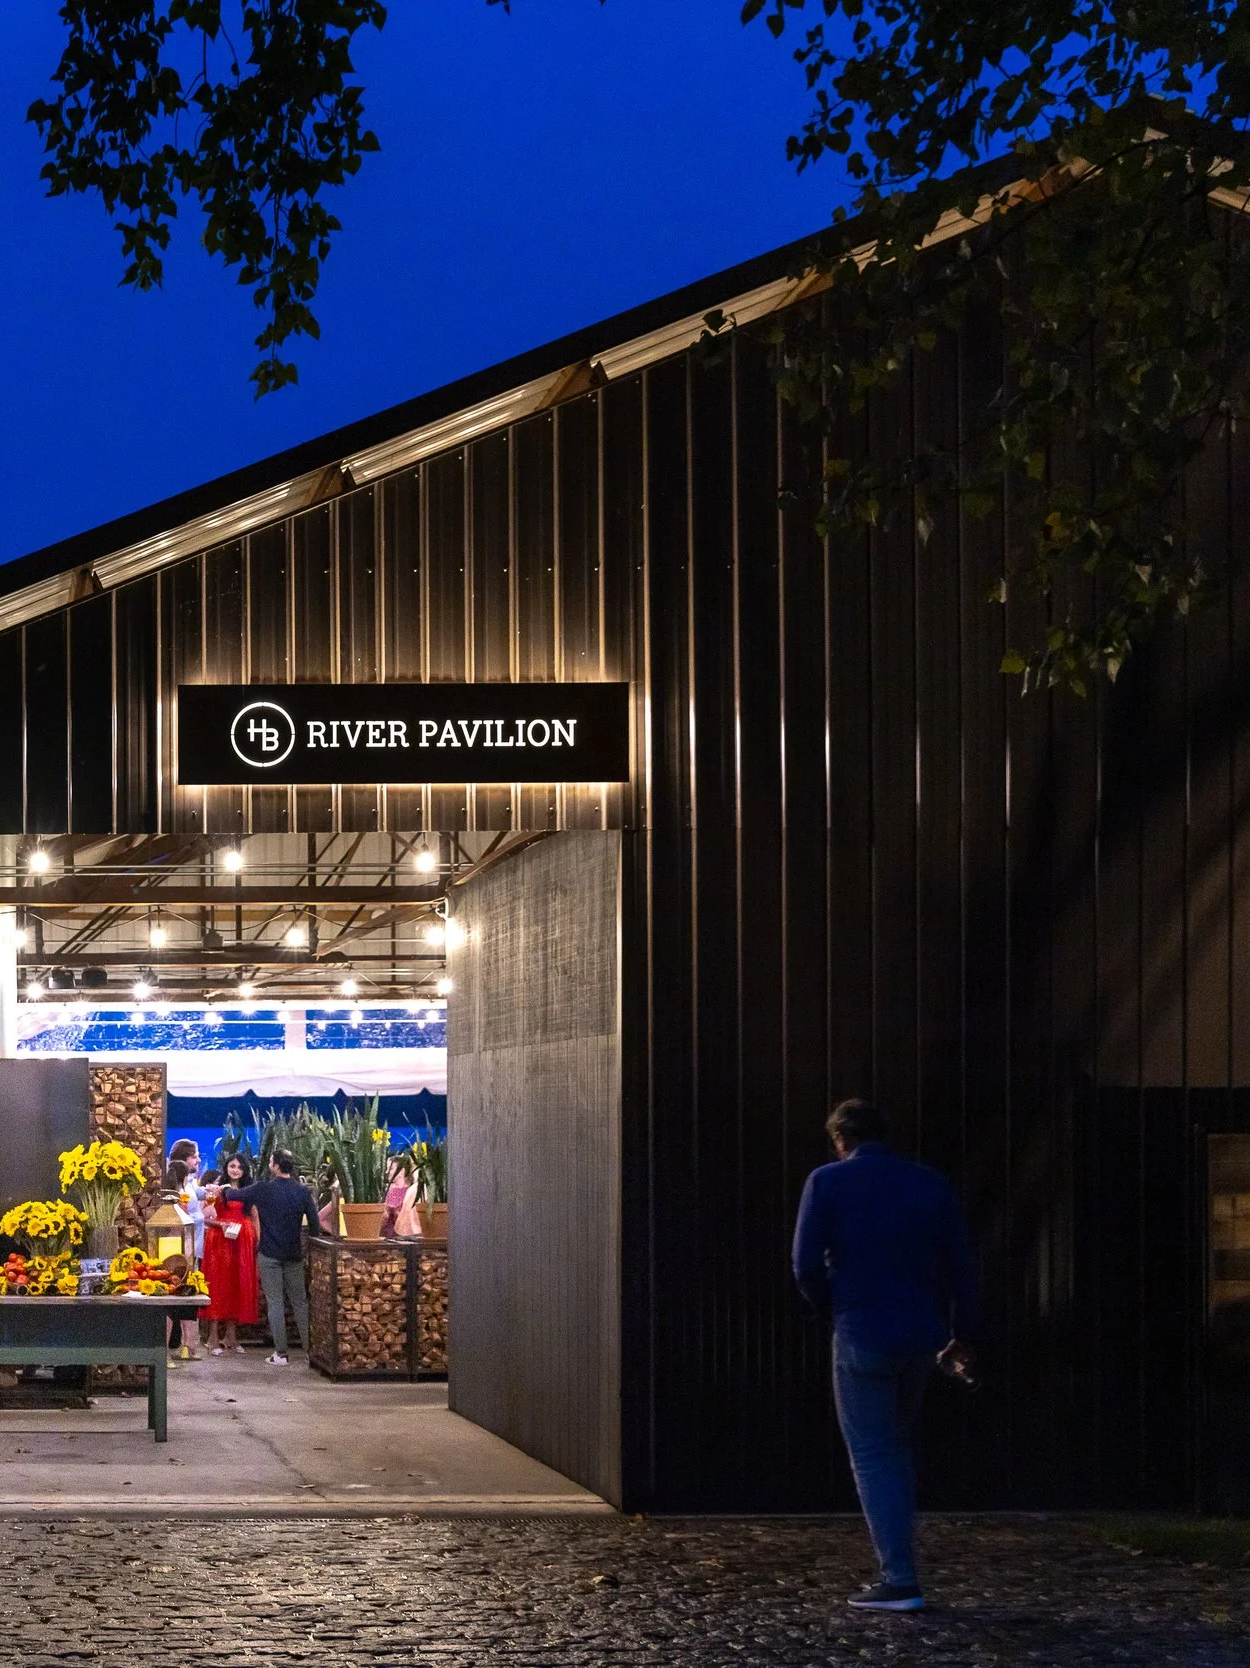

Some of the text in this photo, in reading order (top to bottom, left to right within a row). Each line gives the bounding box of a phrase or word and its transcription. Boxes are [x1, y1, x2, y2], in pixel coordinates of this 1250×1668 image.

[246, 718, 280, 752] HB
[306, 718, 578, 749] RIVER PAVILION
